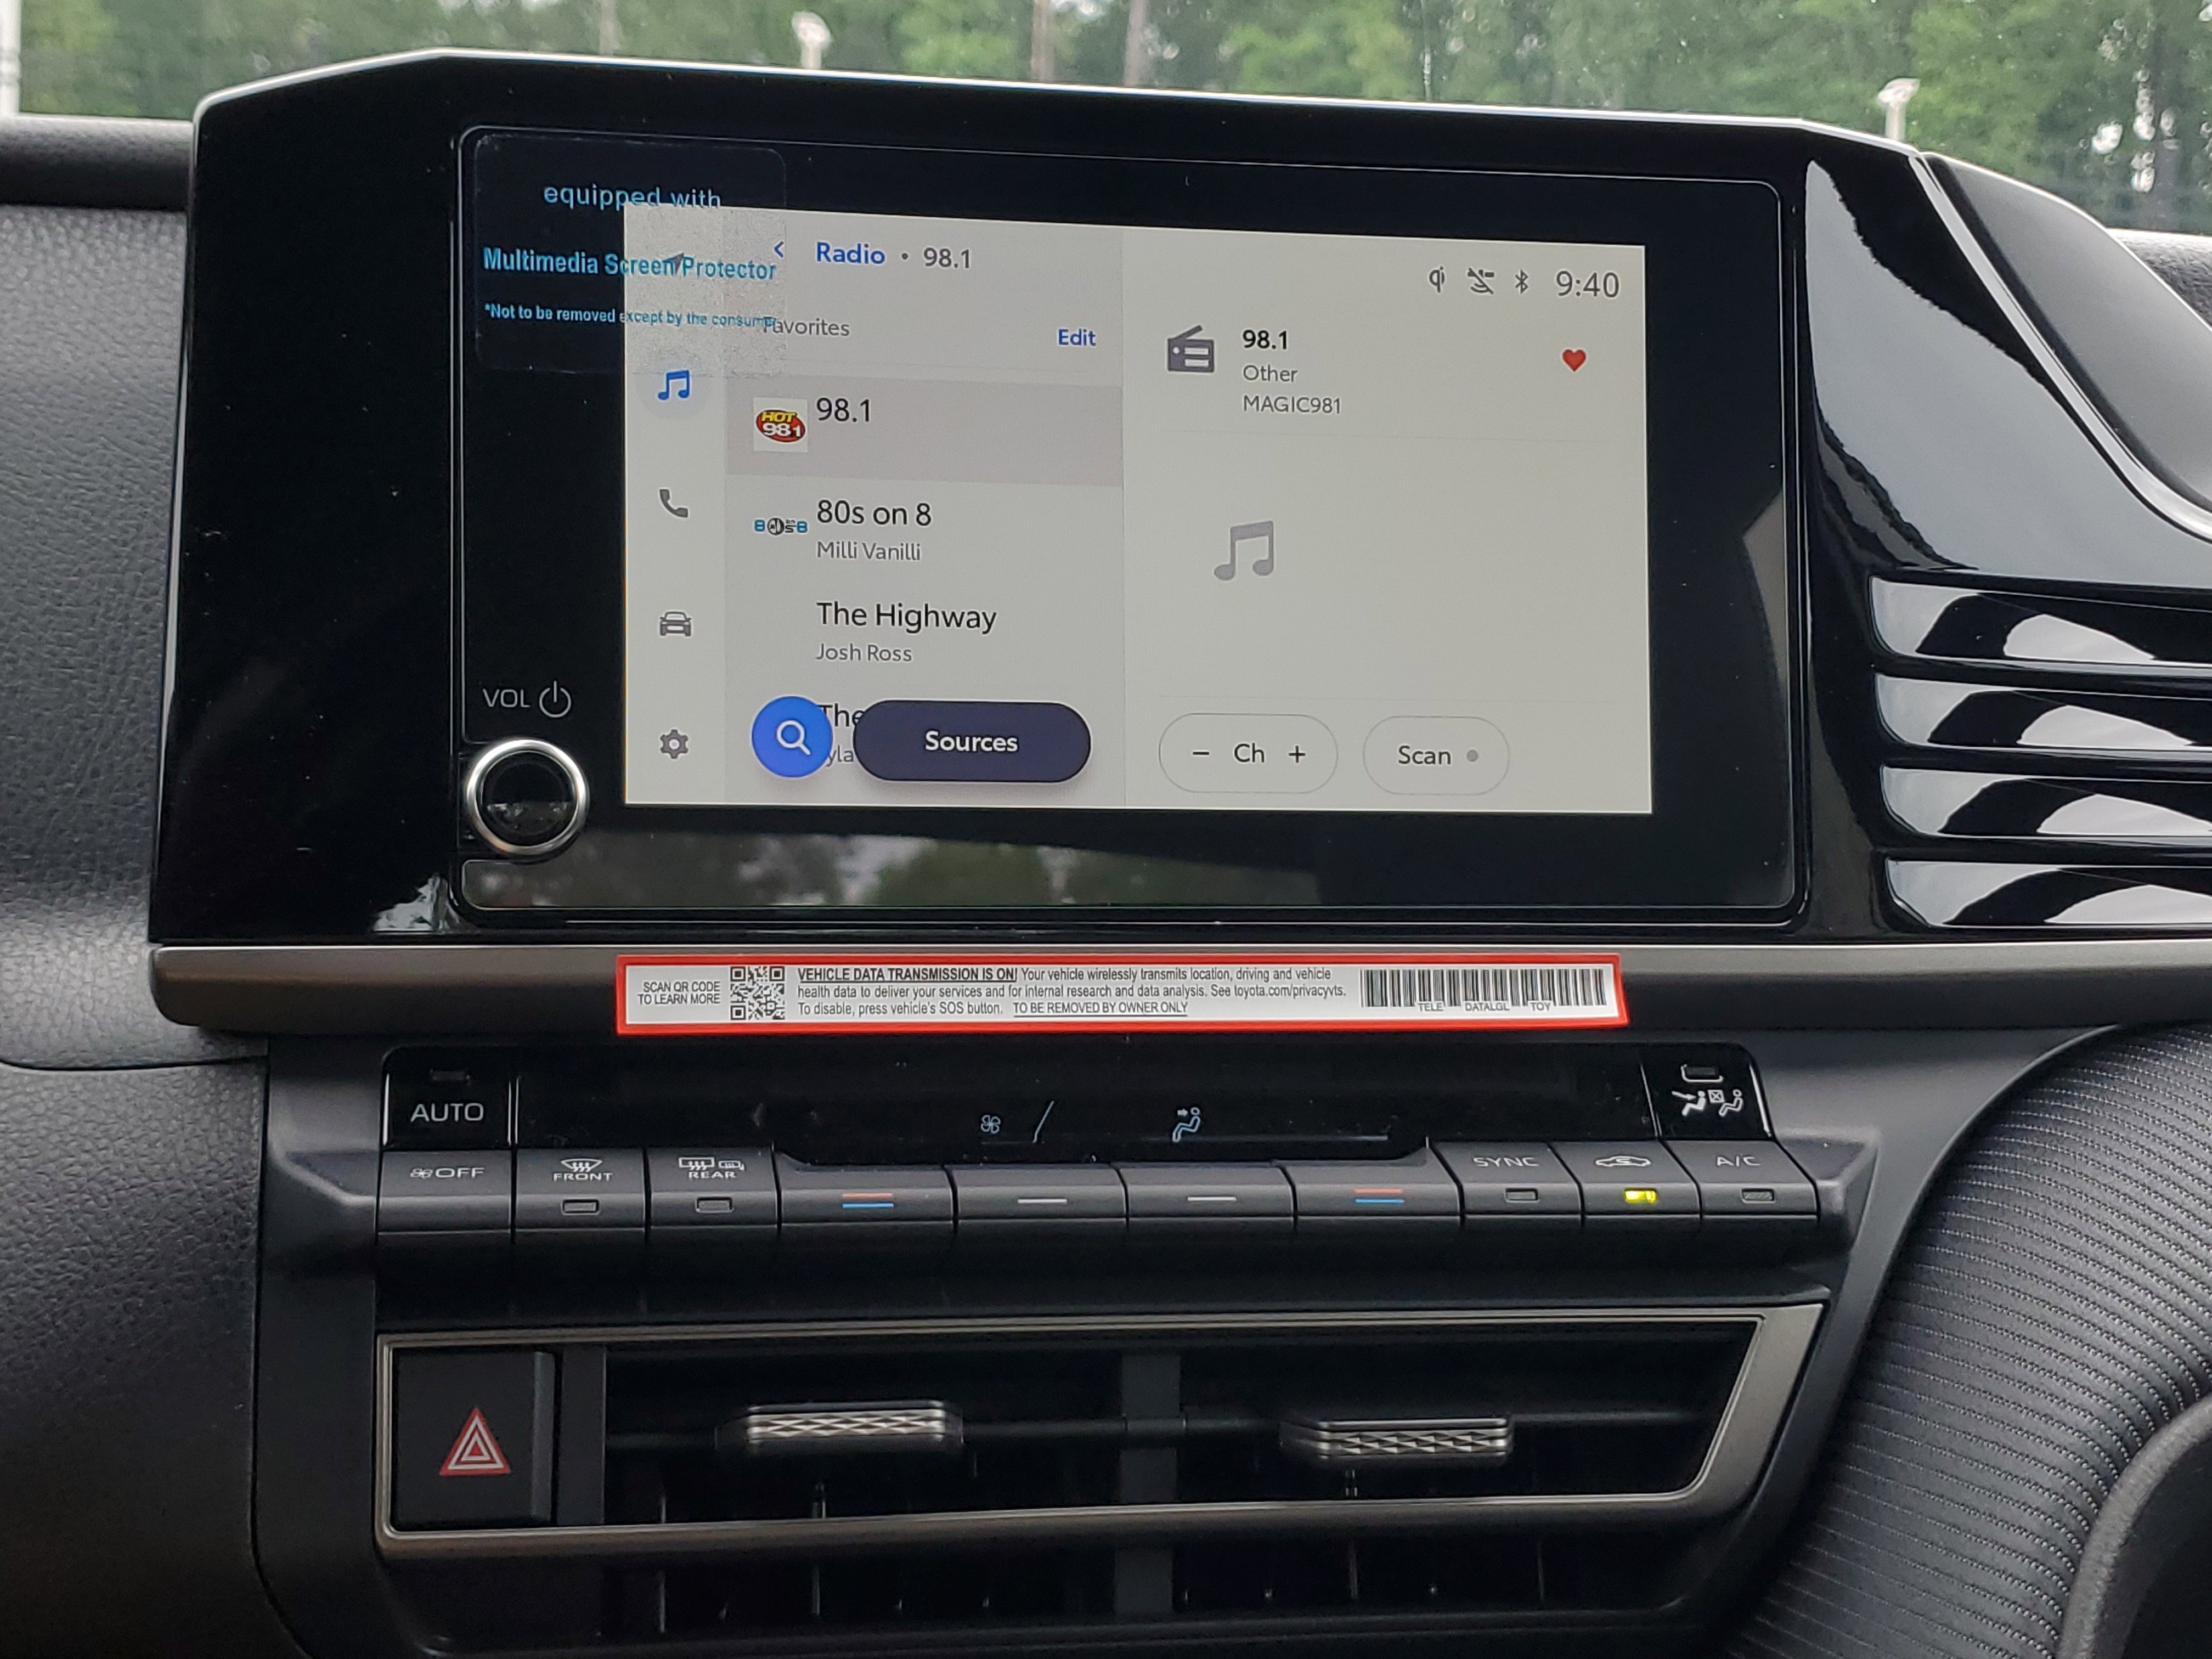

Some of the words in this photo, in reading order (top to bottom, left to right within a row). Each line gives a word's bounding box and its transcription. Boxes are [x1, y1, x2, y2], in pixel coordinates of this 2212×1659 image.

[544, 184, 661, 212] equipped
[670, 189, 721, 207] with
[483, 246, 599, 274] Multimedia
[605, 253, 675, 275] Screen
[681, 256, 776, 280] Protector
[816, 242, 885, 264] Radio
[924, 247, 970, 269] 98.1
[1556, 270, 1620, 298] 9:40
[518, 306, 532, 319] to
[536, 305, 553, 320] be
[557, 309, 616, 323] removed
[619, 310, 663, 325] except
[667, 311, 683, 326] by
[687, 312, 707, 325] the
[1058, 329, 1097, 346] Edit
[1243, 329, 1287, 349] 98.1
[1243, 364, 1298, 382] Other
[816, 397, 871, 422] 98.1
[1243, 394, 1340, 415] MAGIC981
[761, 411, 795, 422] HOT
[816, 500, 865, 524] 80s
[873, 505, 908, 526] on
[916, 503, 932, 526] 8
[817, 541, 857, 560] Milli
[863, 543, 921, 561] Vanilli
[816, 602, 868, 626] The
[876, 604, 997, 634] Highway
[816, 644, 861, 661] Josh
[868, 645, 913, 662] Ross
[483, 689, 531, 708] VOL
[925, 730, 1019, 752] Sources
[1234, 743, 1265, 763] Ch
[1397, 746, 1452, 765] Scan
[798, 968, 850, 980] VEHICLE
[854, 968, 885, 980] DATA
[888, 968, 979, 980] TRANSMISSION
[982, 968, 994, 980] IS
[996, 968, 1018, 981] ON!
[1022, 968, 1045, 980] Your
[1048, 968, 1084, 980] vehicle
[1087, 968, 1137, 983] wirelessly
[1141, 968, 1187, 980] transmits
[1190, 967, 1233, 981] location,
[1236, 967, 1269, 983] driving
[1273, 967, 1292, 979] and
[1295, 967, 1331, 979] vehicle
[644, 981, 671, 992] SCAN
[673, 981, 688, 992] QR
[692, 981, 720, 992] CODE
[798, 985, 830, 998] health
[833, 985, 857, 998] data
[860, 986, 871, 998] to
[874, 985, 910, 998] deliver
[913, 987, 936, 1001] your
[939, 985, 982, 997] services
[985, 985, 1005, 997] and
[1008, 984, 1023, 997] for
[1025, 984, 1063, 997] internal
[1067, 985, 1111, 997] research
[1115, 984, 1134, 997] and
[1137, 984, 1160, 997] data
[1163, 984, 1207, 1000] analysis.
[1211, 984, 1231, 997] See
[638, 994, 652, 1005] TO
[655, 994, 687, 1005] LEARN
[690, 994, 720, 1004] MORE
[798, 1002, 811, 1015] To
[814, 1002, 855, 1017] disable,
[858, 1005, 888, 1017] press
[890, 1002, 936, 1015] vehicle's
[939, 1002, 964, 1014] SOS
[967, 1001, 1003, 1014] button.
[1014, 1002, 1028, 1013] TO
[1030, 1002, 1045, 1013] BE
[1047, 1002, 1100, 1013] REMOVED
[1102, 1002, 1116, 1013] BY
[1119, 1002, 1159, 1013] OWNER
[1160, 1001, 1188, 1013] ONLY
[1418, 1002, 1444, 1012] TELE
[1530, 1002, 1551, 1011] TOY
[410, 1103, 484, 1122] AUTO
[1473, 1157, 1539, 1167] SYNC
[1717, 1156, 1760, 1166] A/C
[435, 1167, 484, 1178] OFF
[554, 1172, 612, 1181] FRONT
[688, 1171, 736, 1179] REAR
